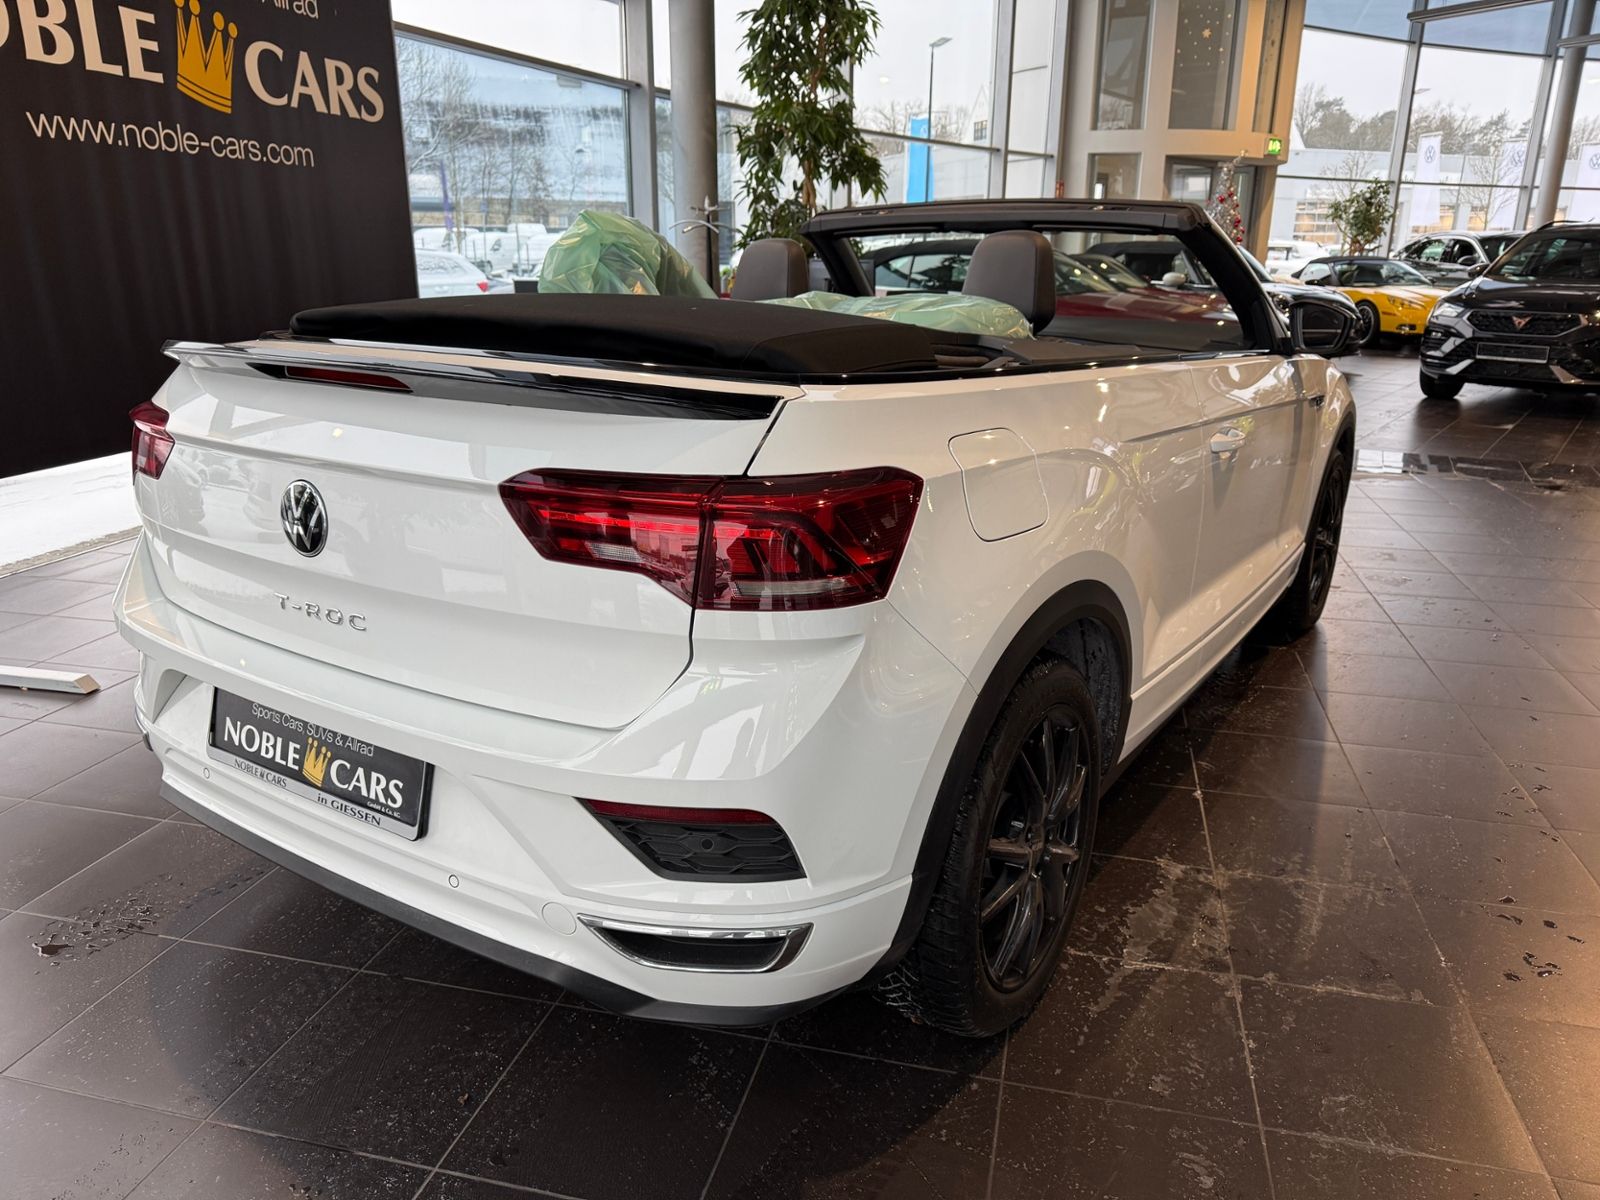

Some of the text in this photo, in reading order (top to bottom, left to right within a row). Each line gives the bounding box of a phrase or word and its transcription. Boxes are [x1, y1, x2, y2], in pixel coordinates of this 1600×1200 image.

[0, 0, 384, 123] BLE CARS
[25, 111, 315, 167] www.noble-cars.com
[274, 592, 367, 631] T-ROC
[252, 702, 281, 725] Sports
[306, 723, 333, 743] SUVs
[335, 734, 344, 746] &
[344, 737, 375, 757] Allrad
[224, 716, 403, 809] NOBLE CARS
[234, 758, 287, 788] NOBLE CARS
[317, 792, 381, 826] in GIESSEN
